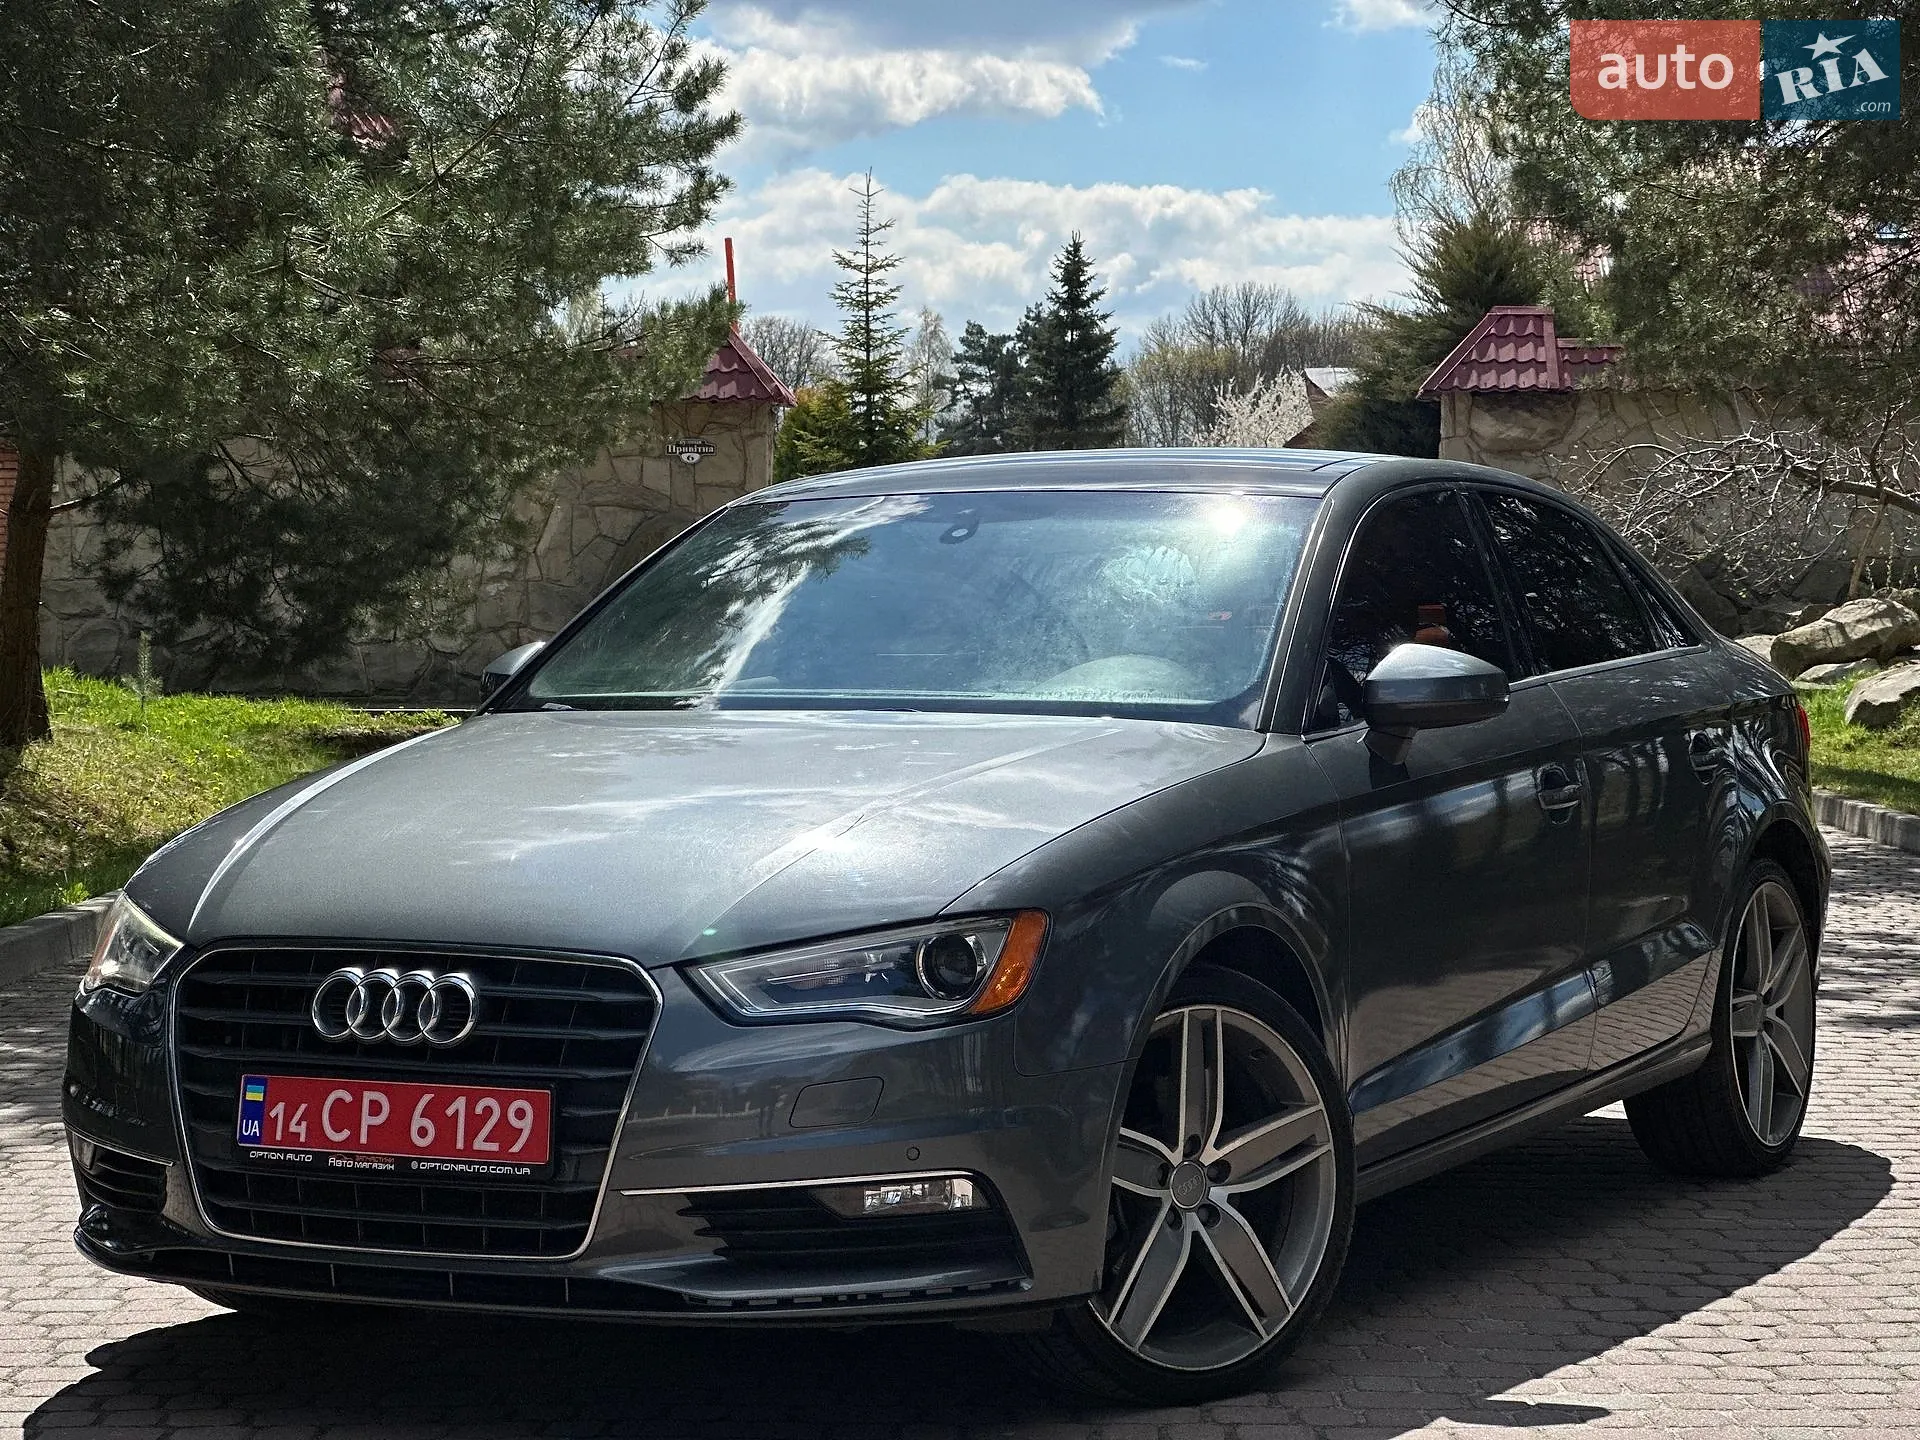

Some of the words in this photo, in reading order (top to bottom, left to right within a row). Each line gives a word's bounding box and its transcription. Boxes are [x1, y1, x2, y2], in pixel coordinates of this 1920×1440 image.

[242, 1120, 260, 1137] UA
[269, 1102, 308, 1143] 14
[321, 1089, 391, 1145] CP
[409, 1093, 534, 1153] 6129
[286, 1153, 313, 1162] AUTO
